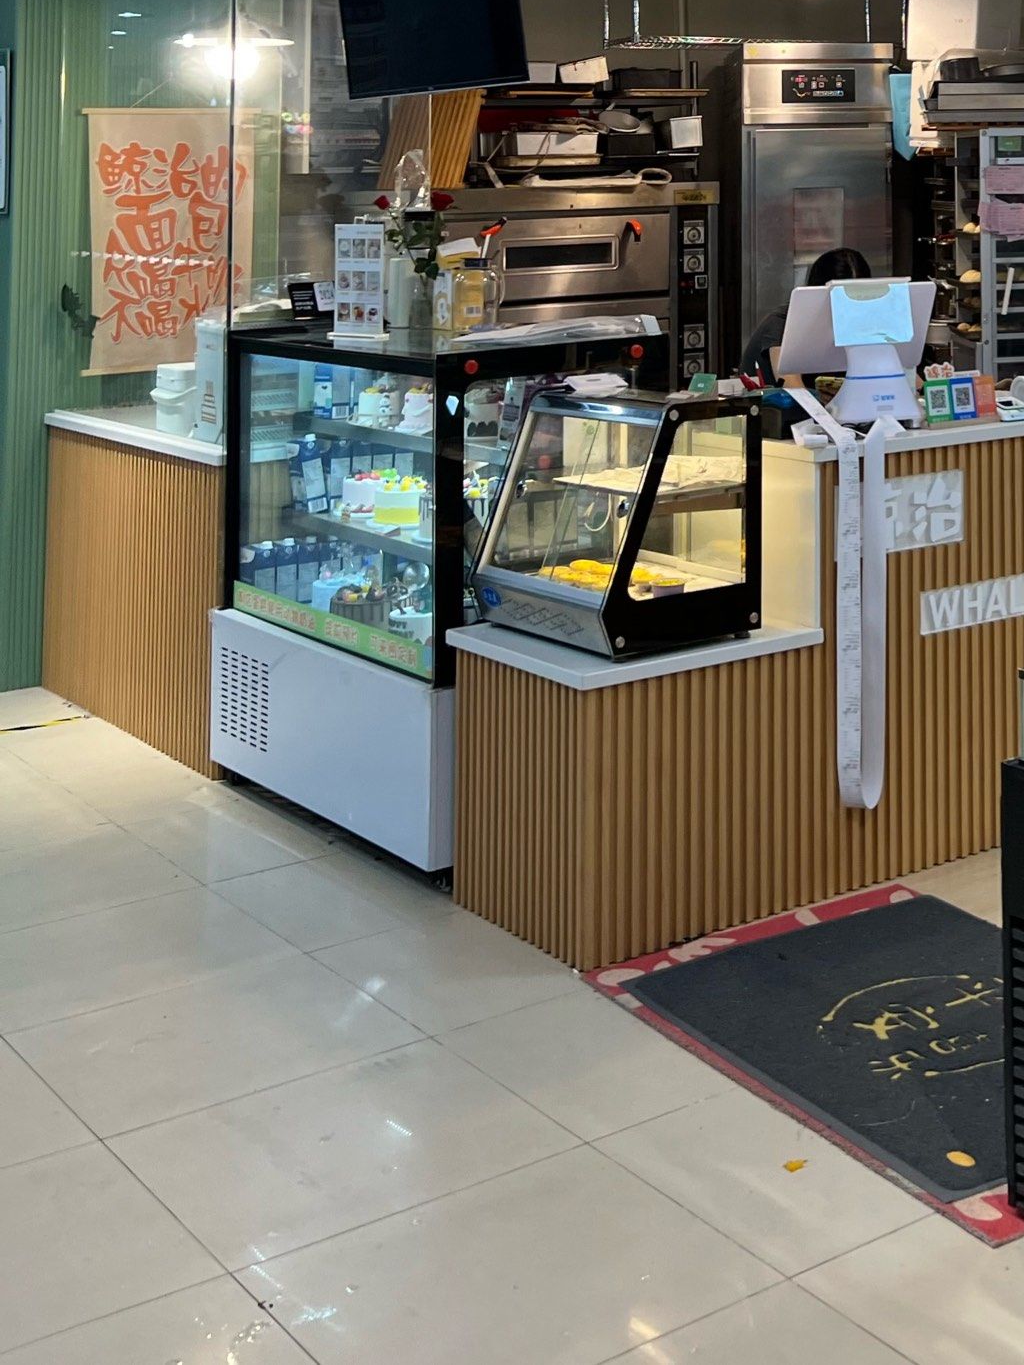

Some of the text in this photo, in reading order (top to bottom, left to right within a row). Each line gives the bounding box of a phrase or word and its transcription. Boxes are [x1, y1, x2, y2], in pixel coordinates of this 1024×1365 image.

[99, 143, 246, 198] 鲸治的
[115, 191, 227, 254] 面包
